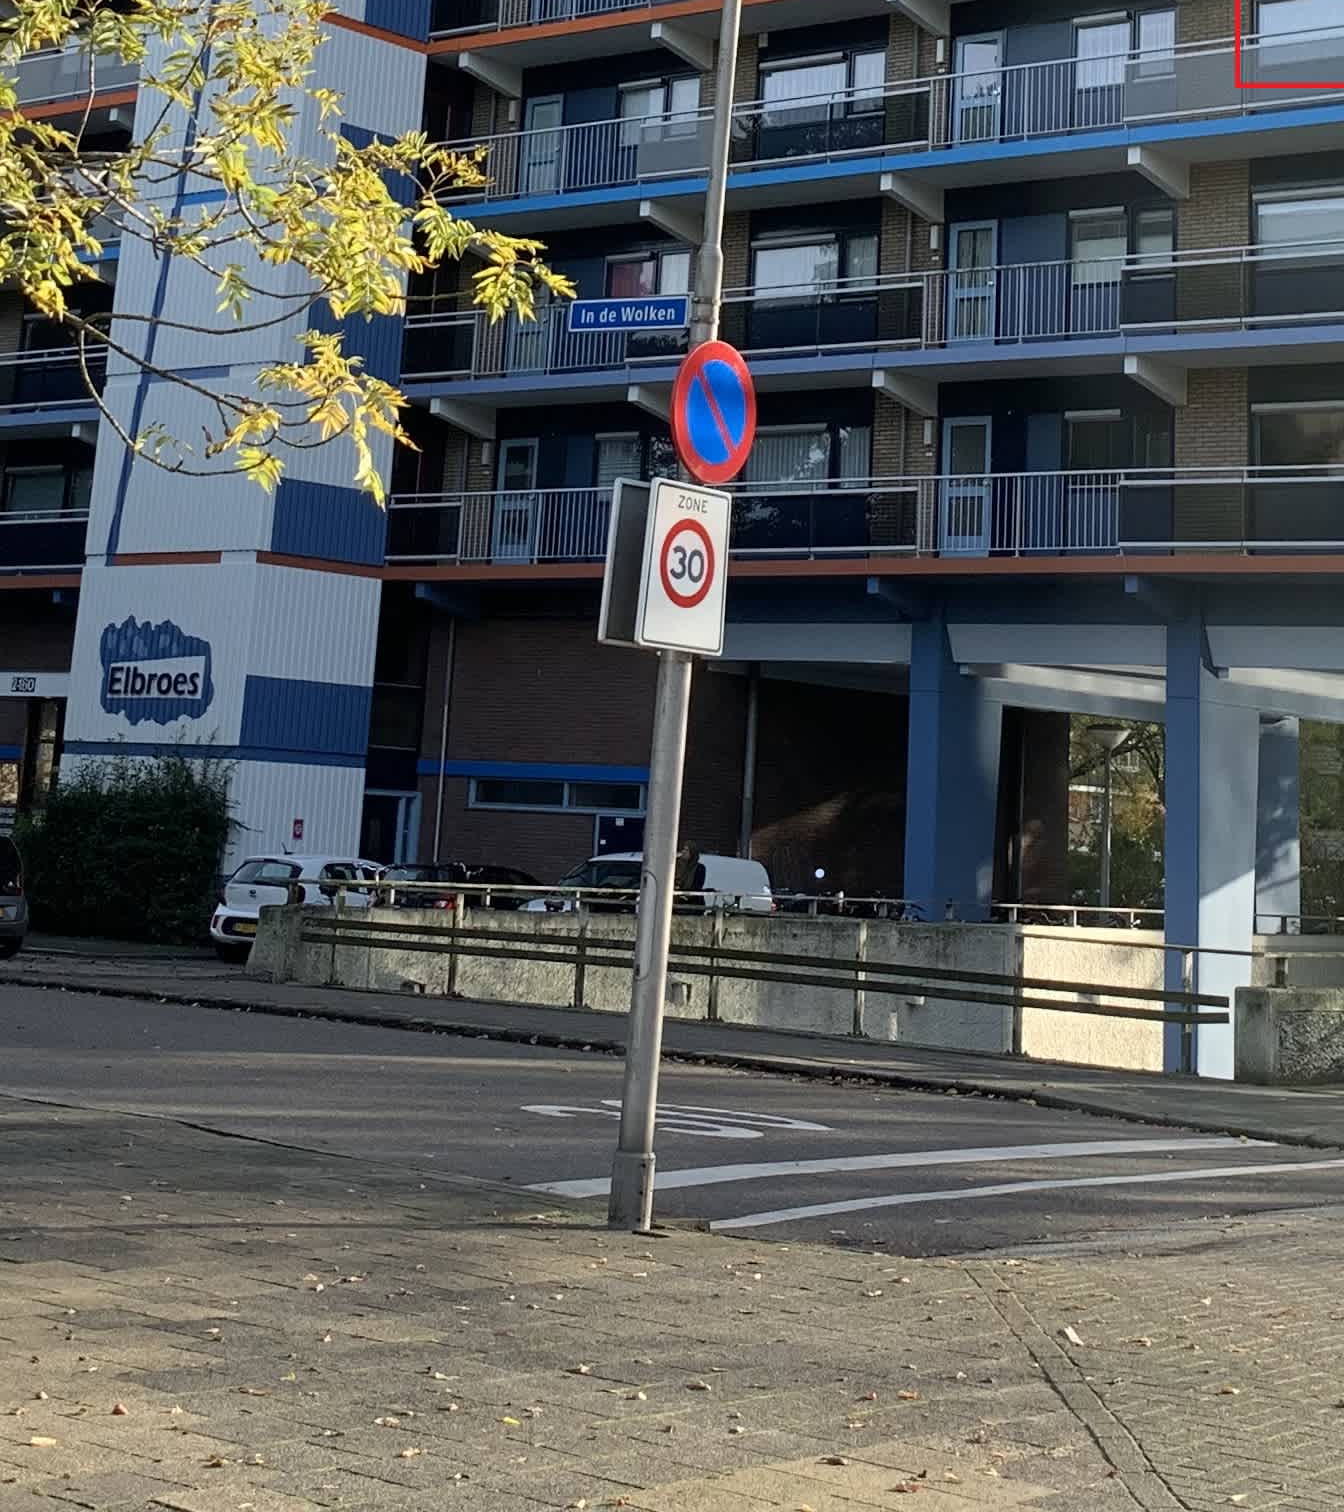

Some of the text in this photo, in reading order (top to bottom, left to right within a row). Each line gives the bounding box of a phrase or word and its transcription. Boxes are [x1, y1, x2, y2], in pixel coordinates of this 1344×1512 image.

[580, 305, 676, 324] In de Wolken
[678, 494, 709, 514] ZONE
[669, 545, 705, 583] 30
[107, 665, 200, 696] Elbroes
